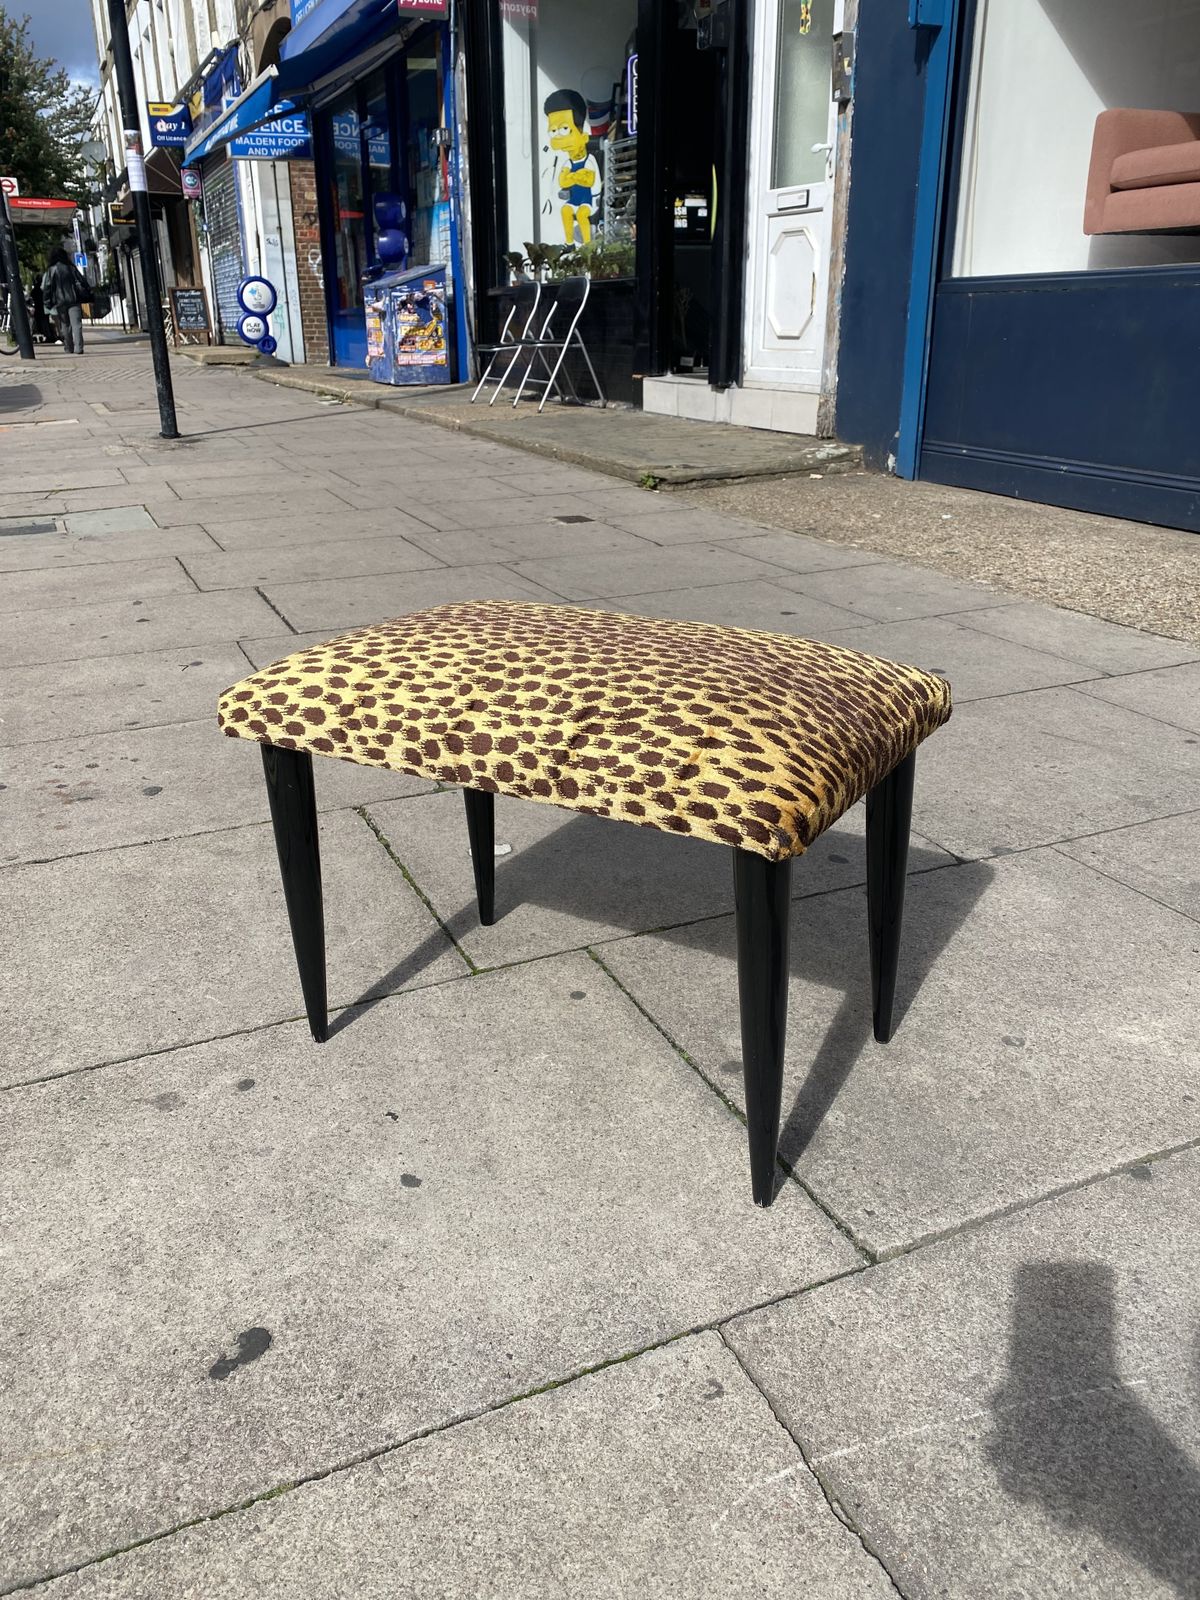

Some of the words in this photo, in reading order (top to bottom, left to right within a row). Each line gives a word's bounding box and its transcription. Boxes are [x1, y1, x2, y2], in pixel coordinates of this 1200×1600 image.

[254, 119, 305, 133] ENCE
[235, 137, 276, 146] MALDEN
[277, 138, 305, 147] FOOD
[248, 147, 269, 156] AND
[270, 149, 295, 157] WINE
